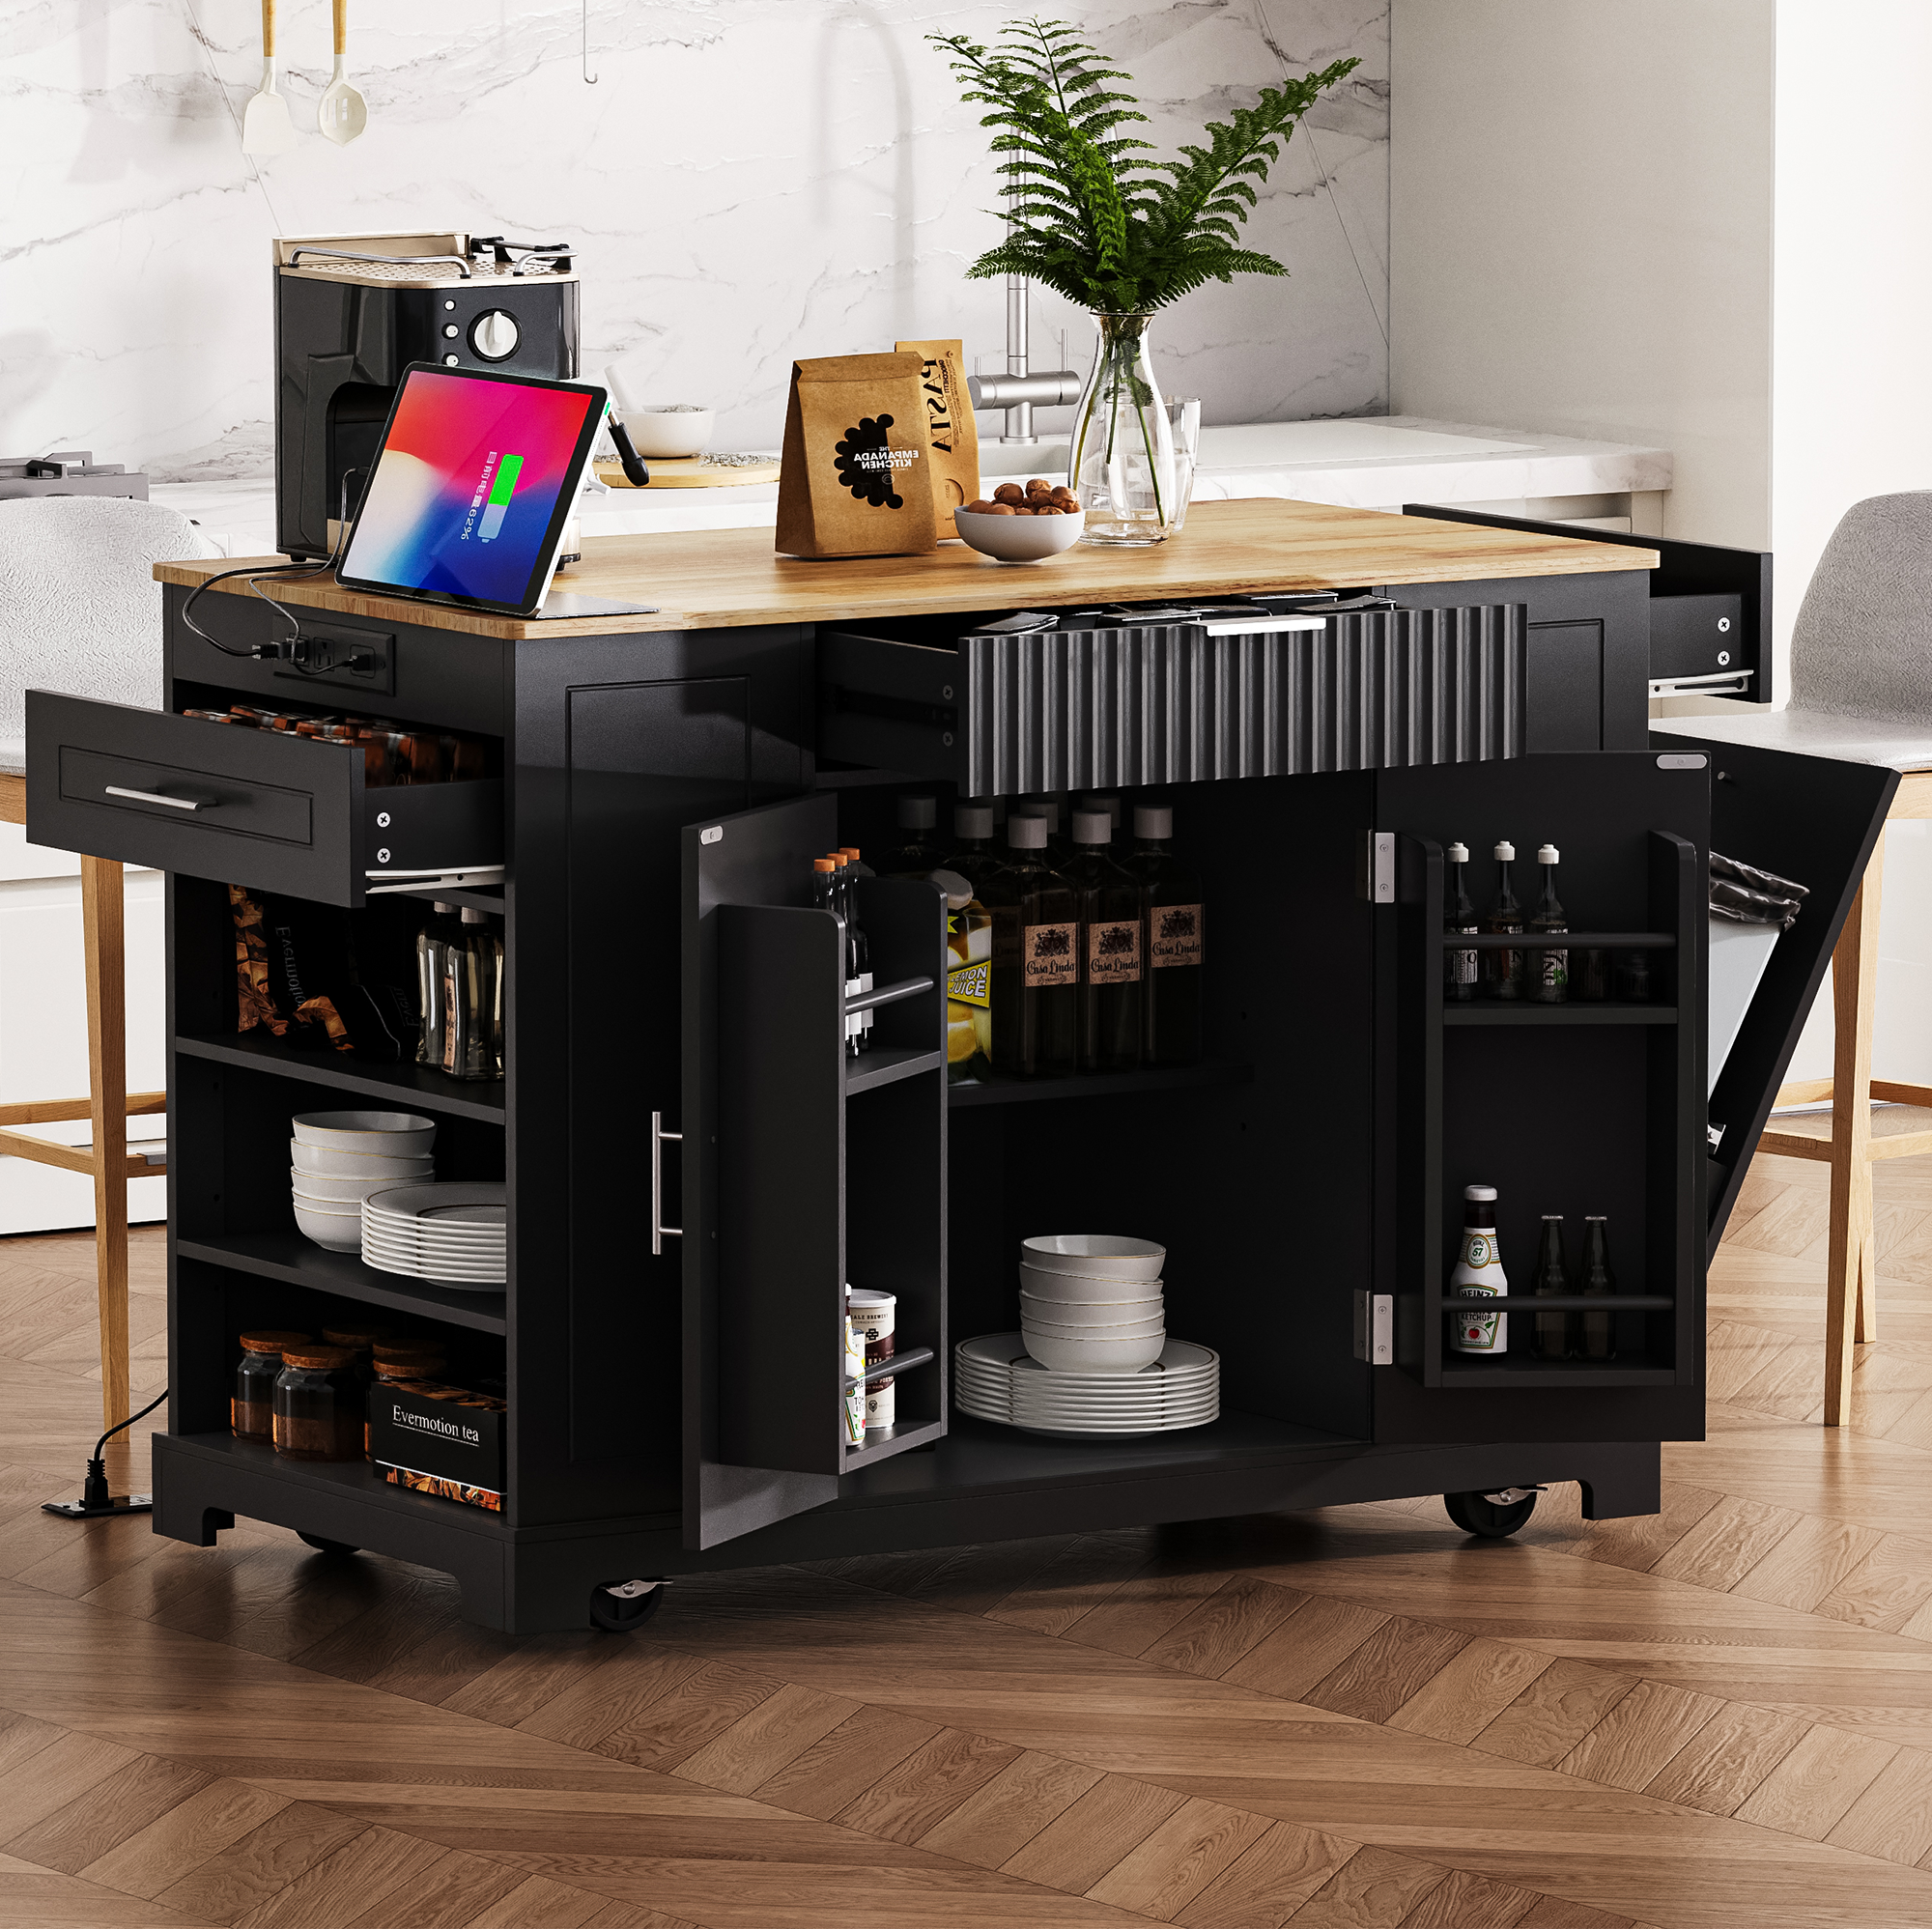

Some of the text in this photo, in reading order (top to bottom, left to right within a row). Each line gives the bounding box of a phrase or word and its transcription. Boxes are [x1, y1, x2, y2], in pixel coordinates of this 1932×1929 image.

[1152, 941, 1201, 956] Casa Linda
[1027, 960, 1075, 976] Casa Linda
[1091, 957, 1139, 973] Casa Linda
[951, 966, 987, 982] LEMON
[949, 979, 986, 998] JUICE
[1472, 1247, 1483, 1257] 57
[392, 1404, 480, 1442] Evermotion tea
